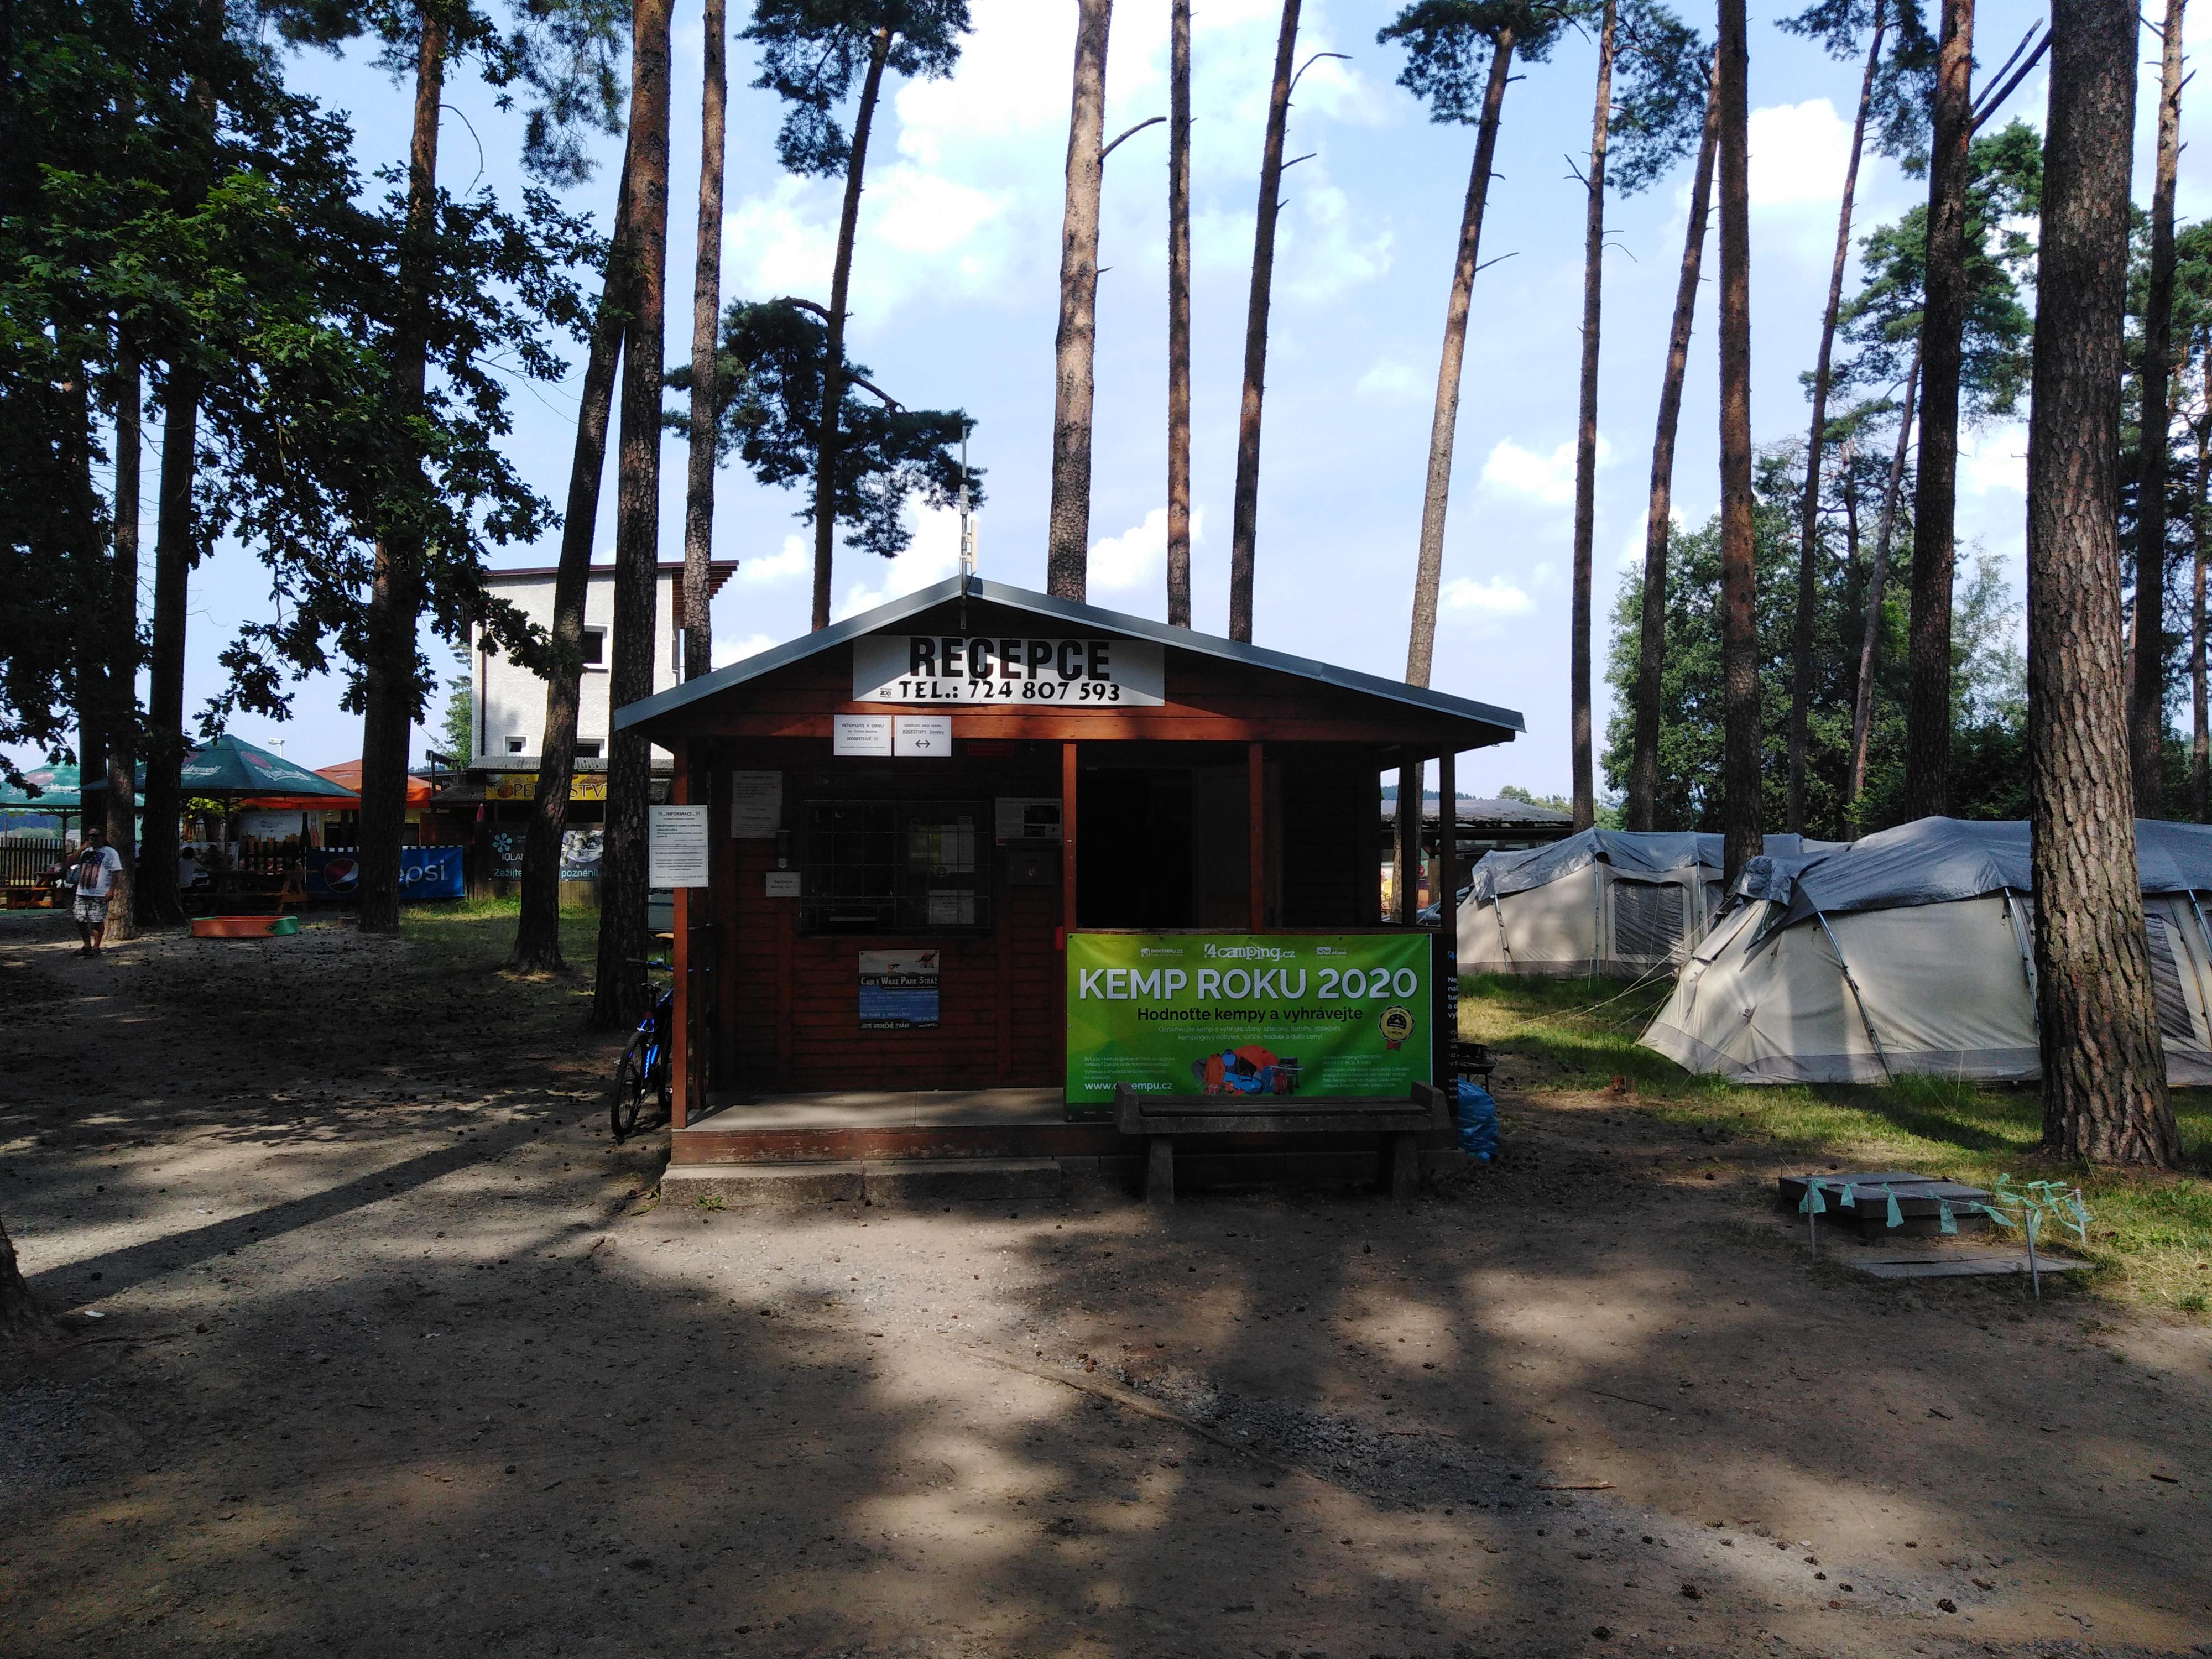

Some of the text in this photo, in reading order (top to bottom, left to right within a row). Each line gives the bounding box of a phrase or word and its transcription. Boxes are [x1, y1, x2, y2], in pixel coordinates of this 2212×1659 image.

[910, 637, 1110, 681] RECEPCE
[898, 681, 1120, 701] TEL.: 724 807 593
[1079, 967, 1418, 1000] KEMP ROKU 2020
[1137, 1006, 1363, 1024] Hodnoťte kempy a vyhrávejte
[1084, 1082, 1173, 1092] www.empu.cz
